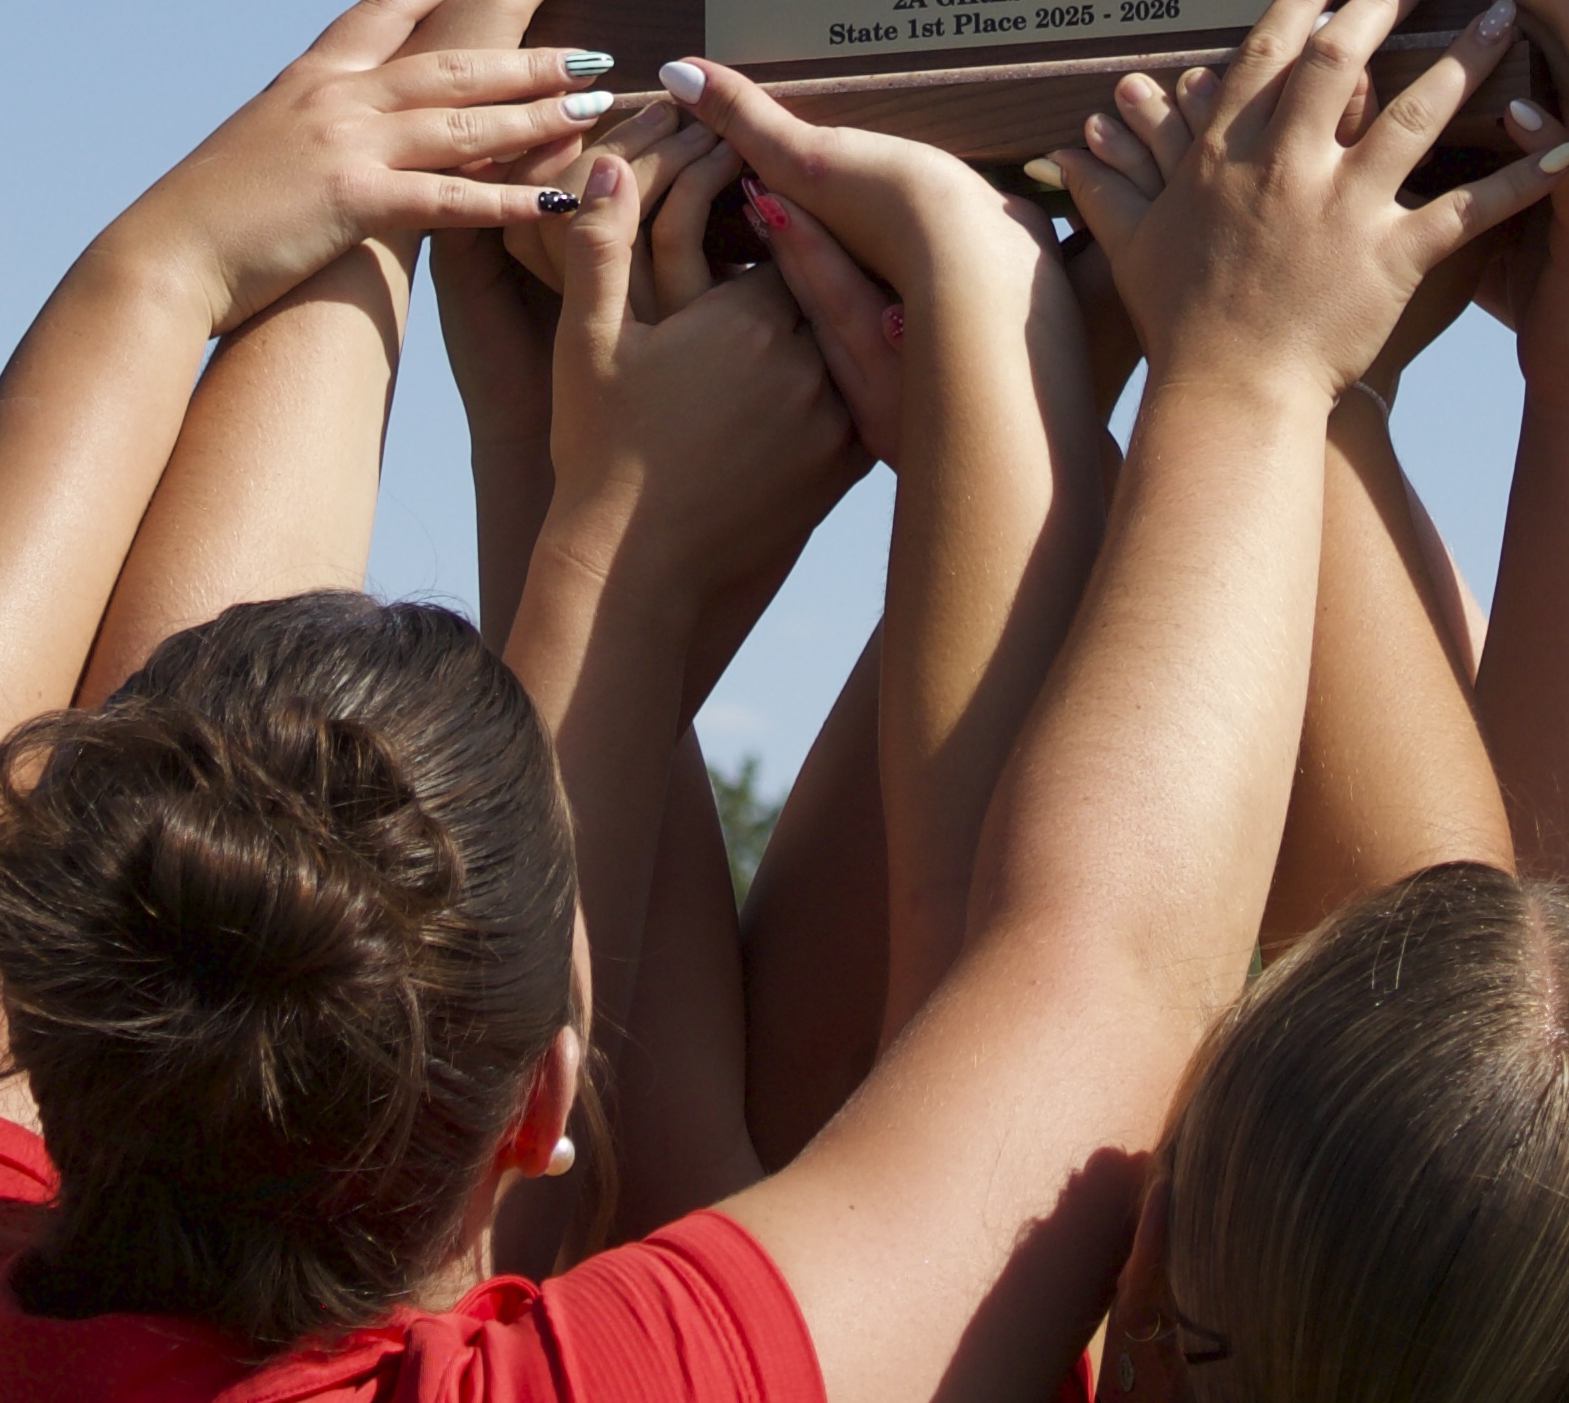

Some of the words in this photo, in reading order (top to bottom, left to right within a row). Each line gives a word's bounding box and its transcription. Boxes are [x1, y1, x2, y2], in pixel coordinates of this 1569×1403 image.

[828, 22, 898, 45] State
[907, 17, 945, 39] 1st
[953, 11, 1027, 36] Place
[1034, 3, 1095, 29] 2025
